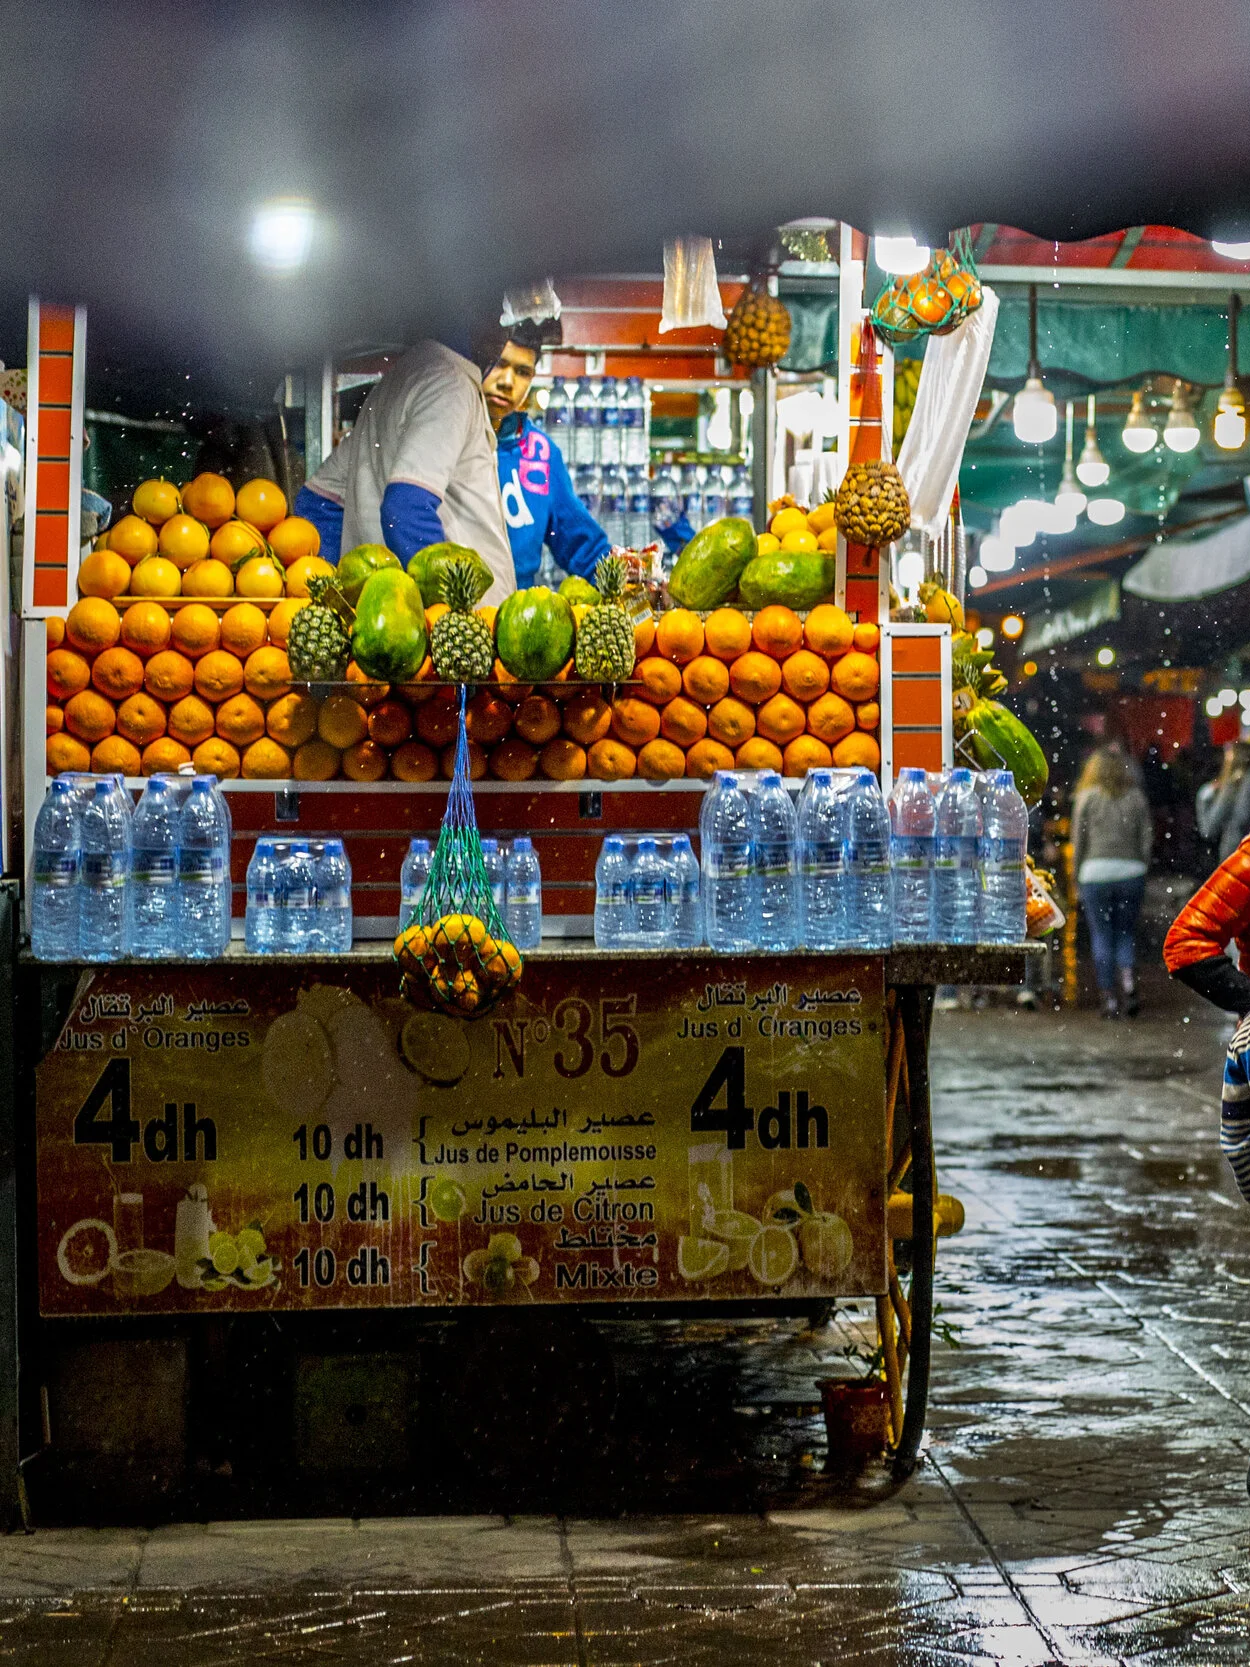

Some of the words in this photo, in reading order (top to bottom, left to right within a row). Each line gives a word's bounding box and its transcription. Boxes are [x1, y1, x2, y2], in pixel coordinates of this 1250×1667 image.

[81, 993, 174, 1023] البرتقال
[184, 997, 249, 1021] عصير
[697, 983, 789, 1012] البرتقال
[795, 985, 863, 1011] عصير
[60, 1028, 102, 1050] Jus
[143, 1028, 250, 1053] Oranges
[677, 1017, 718, 1040] Jus
[758, 1015, 863, 1041] Oranges
[580, 1111, 656, 1133] عصير
[293, 1123, 332, 1160] 10
[344, 1123, 384, 1160] dh
[434, 1143, 469, 1164] Jus
[476, 1143, 499, 1163] de
[506, 1142, 656, 1166] Pomplemousse
[482, 1172, 574, 1198] الحامض
[586, 1175, 656, 1196] عصير
[293, 1182, 334, 1222] 10
[347, 1182, 390, 1222] dh
[473, 1199, 520, 1224] Jus
[531, 1199, 564, 1223] de
[573, 1197, 654, 1222] Citron
[554, 1226, 657, 1249] مختلط
[293, 1248, 335, 1287] 10
[347, 1248, 390, 1286] dh
[556, 1263, 659, 1289] Mixte
